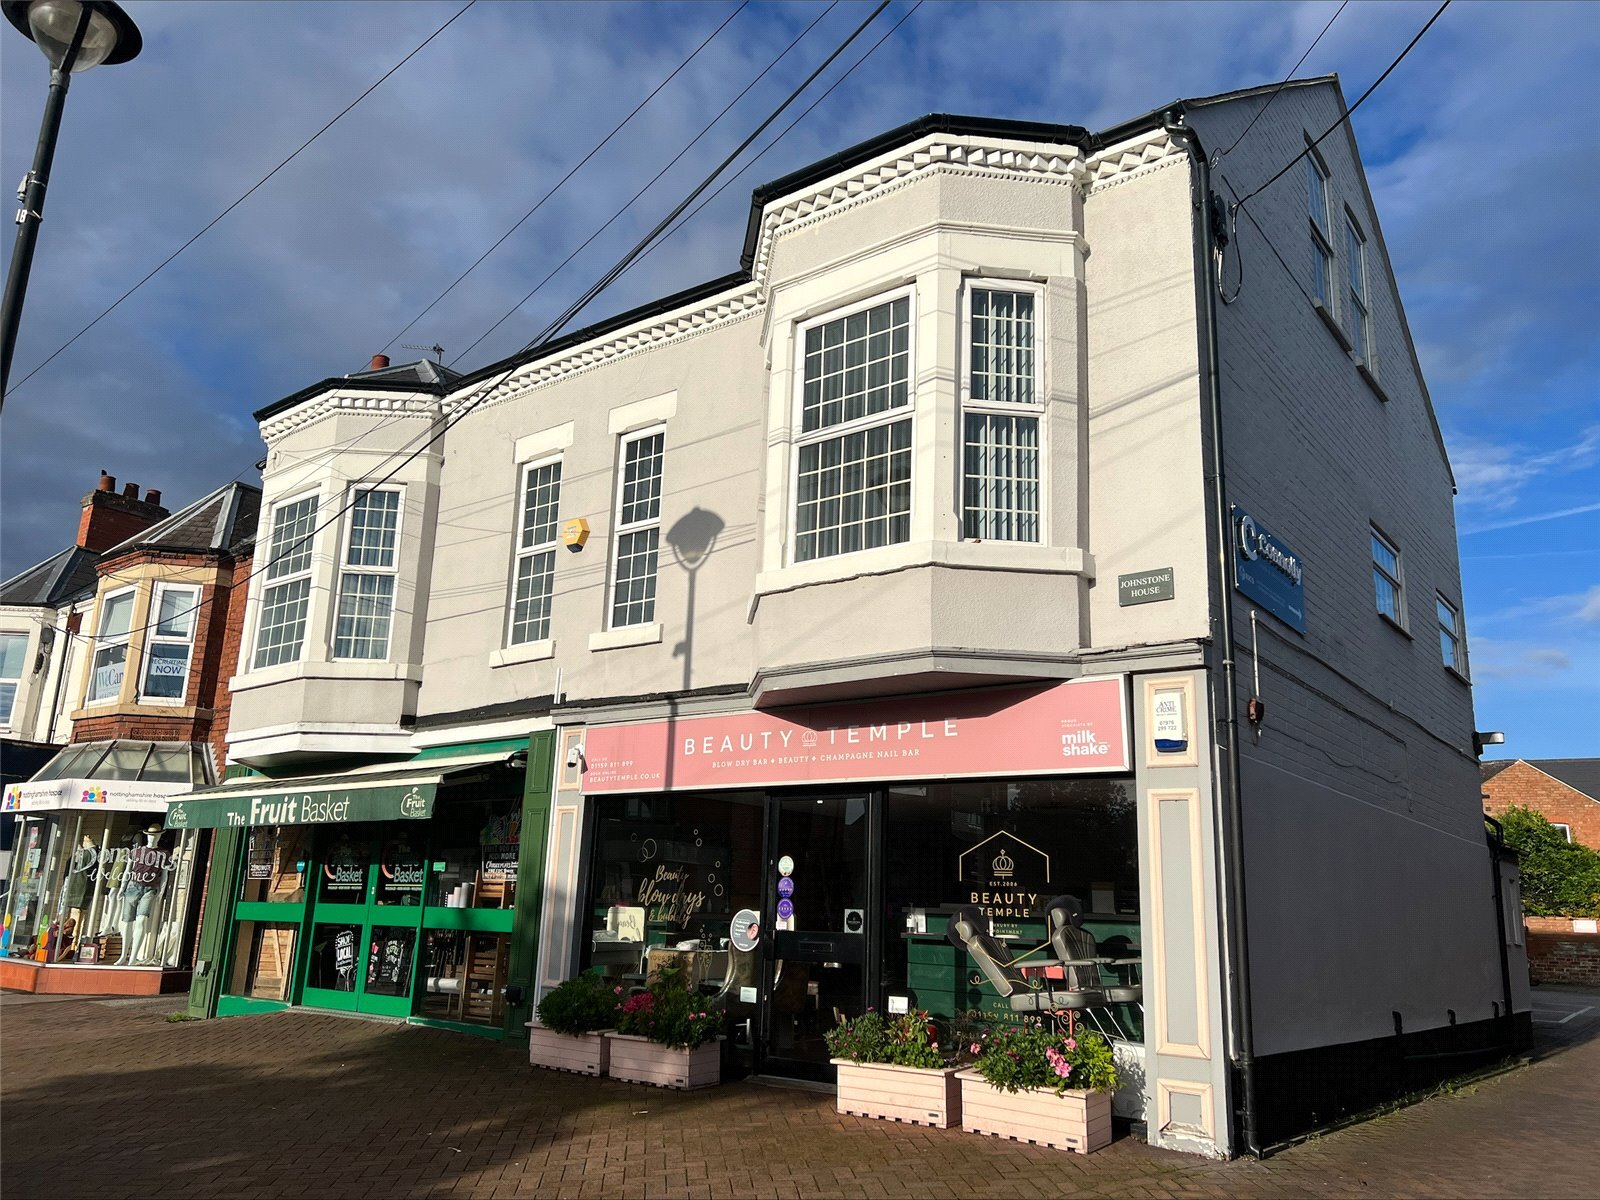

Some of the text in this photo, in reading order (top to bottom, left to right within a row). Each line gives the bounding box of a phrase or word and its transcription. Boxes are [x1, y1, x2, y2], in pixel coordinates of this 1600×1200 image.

[1121, 573, 1171, 589] JOHNSTONE
[1131, 586, 1161, 598] HOUSE
[155, 665, 182, 674] NOW
[685, 717, 959, 756] BEAUTY TEMPLE
[1061, 730, 1096, 744] milk
[712, 749, 920, 768] BLOW DRY BAR BEAUTY CHAMPAGNE NAIL BAR
[589, 773, 660, 783] BEAUTYTEMPLE.CO.UK
[227, 794, 350, 827] The Fruit Basket
[406, 798, 426, 808] Fruit
[72, 841, 180, 874] Donations
[87, 867, 156, 883] welcome
[335, 866, 363, 883] Basket
[393, 866, 424, 883] Basket
[655, 864, 690, 886] Beauty
[638, 877, 671, 906] blow
[970, 892, 1037, 905] BEAUTY
[978, 906, 1030, 918] TEMPLE
[1003, 1013, 1019, 1022] 811
[1024, 1015, 1042, 1023] 899
